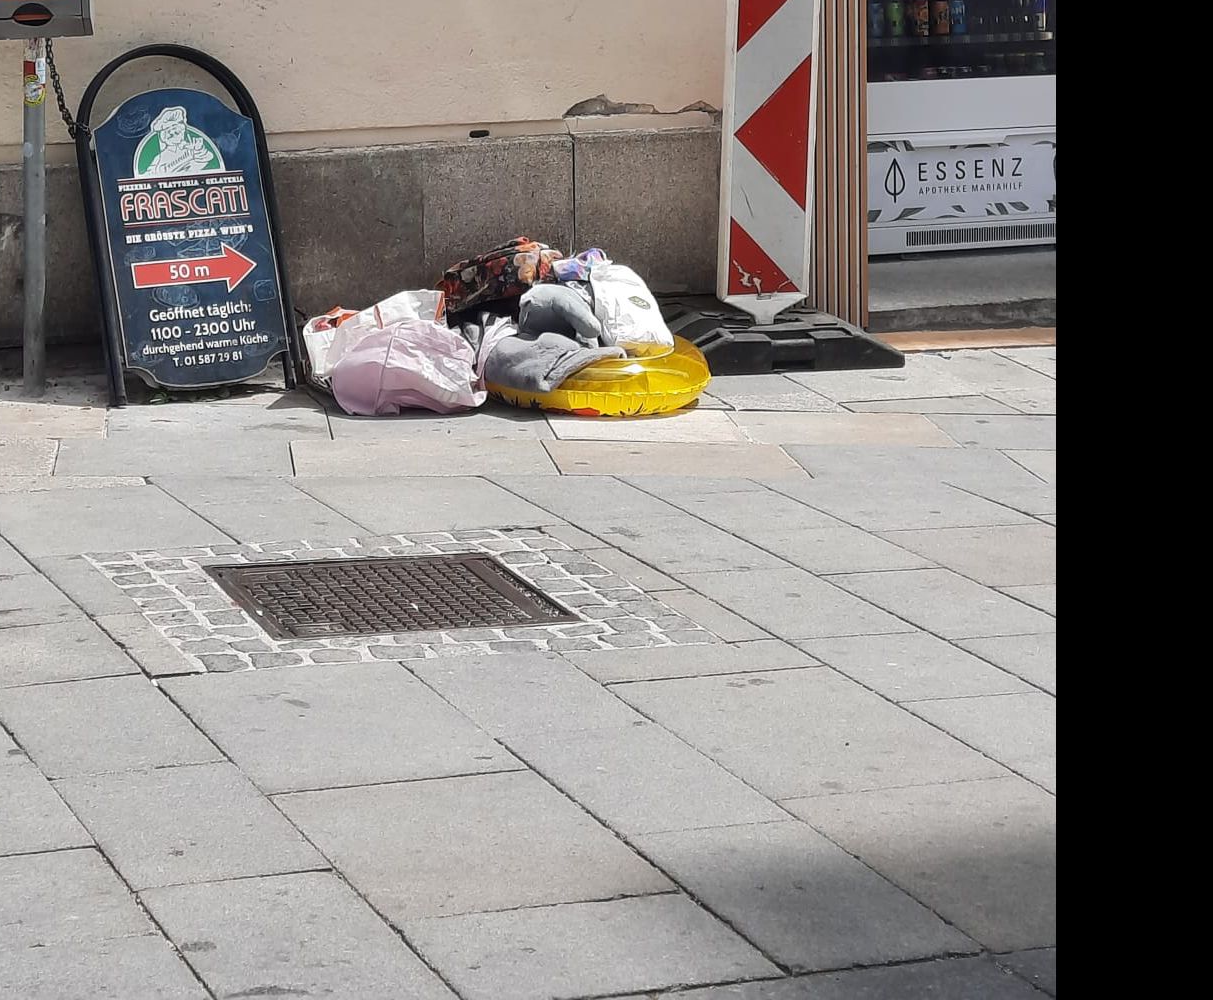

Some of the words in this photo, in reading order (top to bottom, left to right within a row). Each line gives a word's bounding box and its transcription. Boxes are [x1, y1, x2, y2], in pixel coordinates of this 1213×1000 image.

[918, 157, 1023, 182] ESSENZ
[118, 183, 152, 193] PIZZERIA
[157, 179, 199, 190] TRATTORIA
[206, 175, 244, 186] GELATERIA
[918, 184, 968, 196] APOTHEKE
[971, 181, 1024, 193] MARIAHILF
[120, 185, 248, 221] FRASCATI
[126, 235, 143, 244] DIE
[188, 227, 217, 236] PIZZA
[170, 264, 190, 280] 50
[194, 264, 210, 277] m
[149, 307, 205, 322] Geöffnet
[207, 299, 251, 319] täglich:
[232, 318, 256, 333] Uhr
[142, 339, 204, 355] durchgehend
[206, 338, 238, 349] warme
[239, 333, 268, 346] Küche
[173, 357, 183, 367] T.
[184, 355, 196, 366] 01
[198, 353, 215, 364] 587
[216, 352, 230, 362] 29
[232, 350, 243, 361] 81
